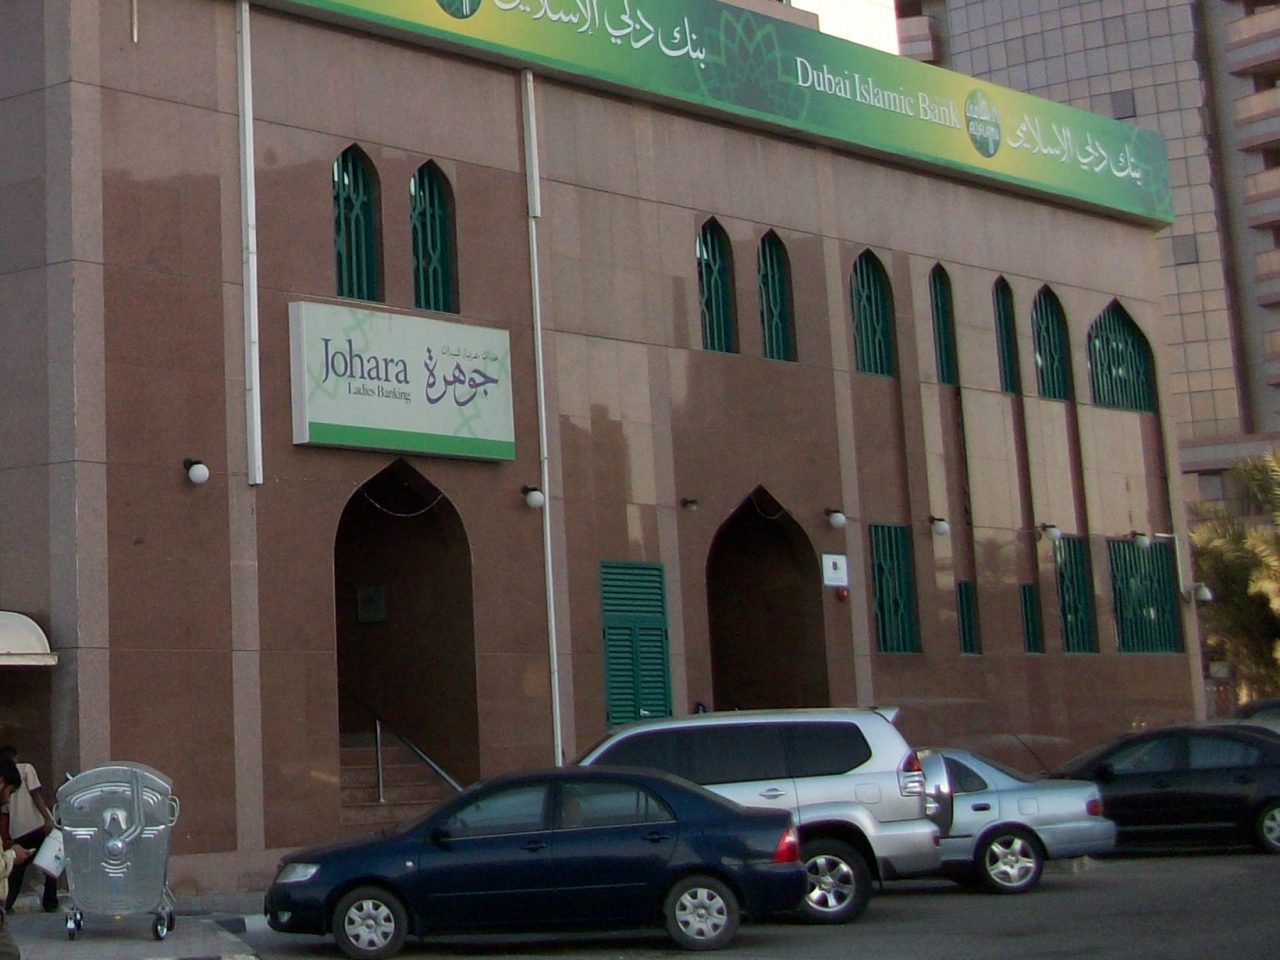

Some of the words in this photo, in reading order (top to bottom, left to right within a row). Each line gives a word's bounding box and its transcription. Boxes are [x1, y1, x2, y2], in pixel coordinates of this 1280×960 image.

[658, 16, 707, 69] بنك
[795, 56, 852, 100] Dubai
[854, 72, 915, 117] Islamic
[917, 91, 961, 129] Bank
[1109, 144, 1142, 186] بنك
[320, 337, 411, 385] Johara
[423, 346, 500, 407] جوهرة
[347, 381, 376, 398] Ladies
[376, 385, 412, 405] Banking
